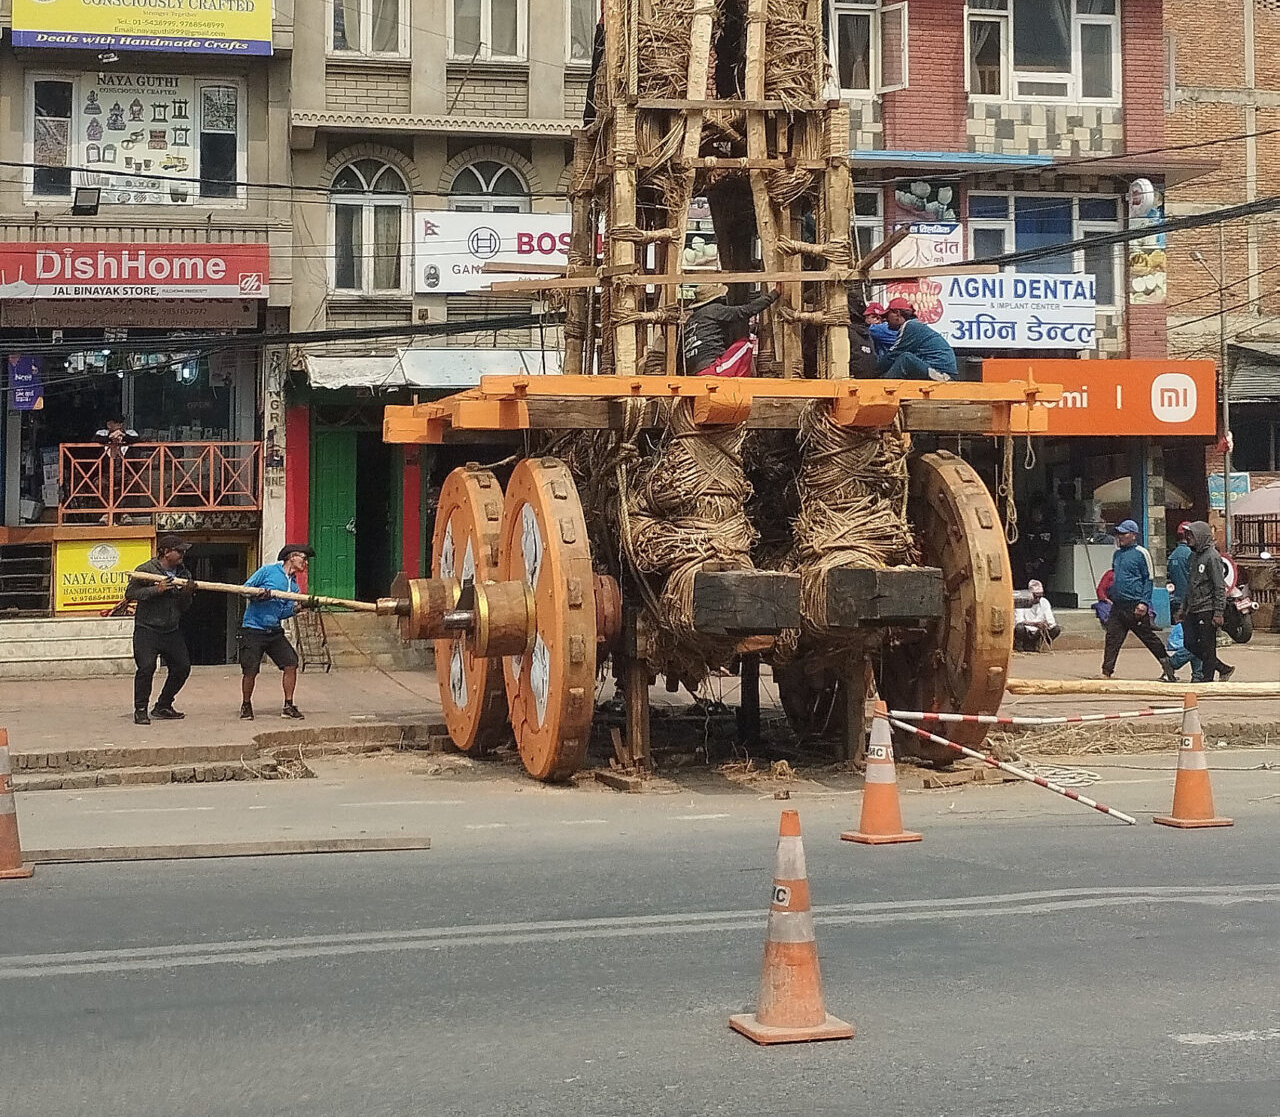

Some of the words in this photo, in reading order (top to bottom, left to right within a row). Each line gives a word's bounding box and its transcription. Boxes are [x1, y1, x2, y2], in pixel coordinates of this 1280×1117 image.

[36, 33, 79, 44] Deals
[82, 35, 115, 46] with
[119, 37, 201, 49] Handmade
[204, 40, 249, 51] Crafts
[97, 74, 133, 86] NAYA
[136, 75, 180, 88] GUTHI
[99, 87, 144, 95] CONSCIOUSLY
[35, 247, 226, 280] DishHome
[52, 286, 72, 296] JAL
[75, 286, 120, 296] BINAYAK
[122, 286, 160, 298] STORE,
[948, 278, 1004, 299] AGNI
[1013, 279, 1096, 300] DENTAL
[996, 302, 1029, 310] IMPLANT
[1030, 303, 1061, 311] CENTER
[950, 313, 1017, 341] अग्नि
[63, 572, 97, 586] NAYA
[63, 586, 111, 595] HANDICRAFT
